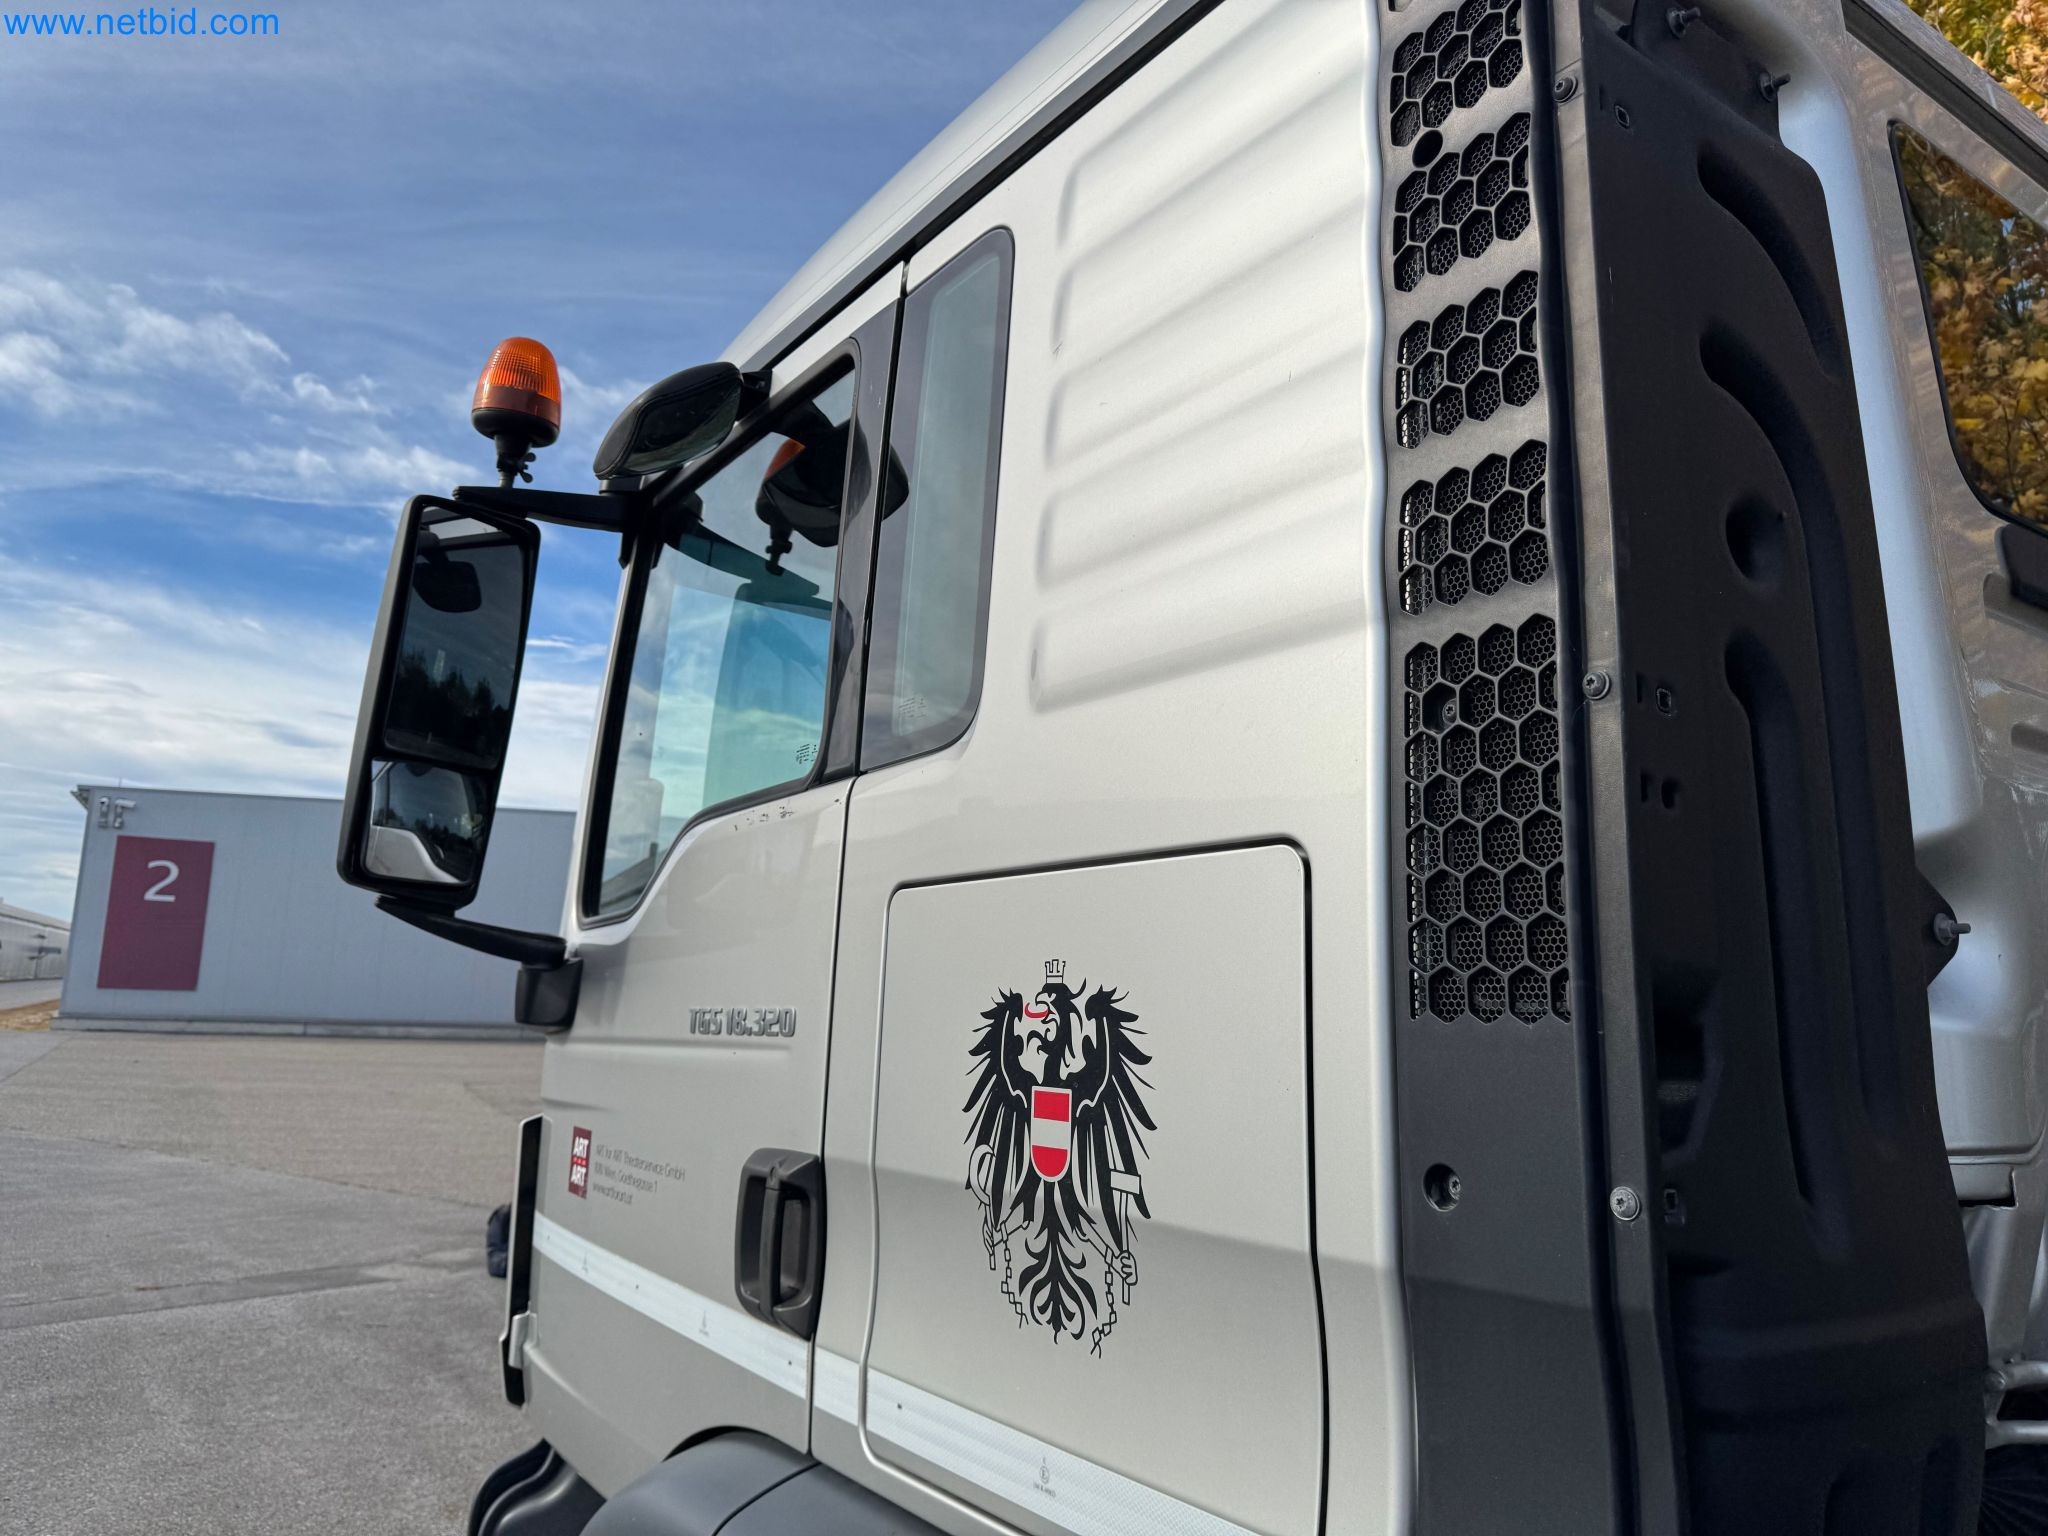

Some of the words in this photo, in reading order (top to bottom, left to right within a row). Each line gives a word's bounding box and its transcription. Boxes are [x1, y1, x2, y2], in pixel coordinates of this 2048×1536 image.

[144, 860, 179, 902] 2
[690, 1007, 723, 1035] TGS
[726, 1007, 797, 1037] 18.320
[573, 1136, 589, 1158] ART
[571, 1164, 587, 1187] ART
